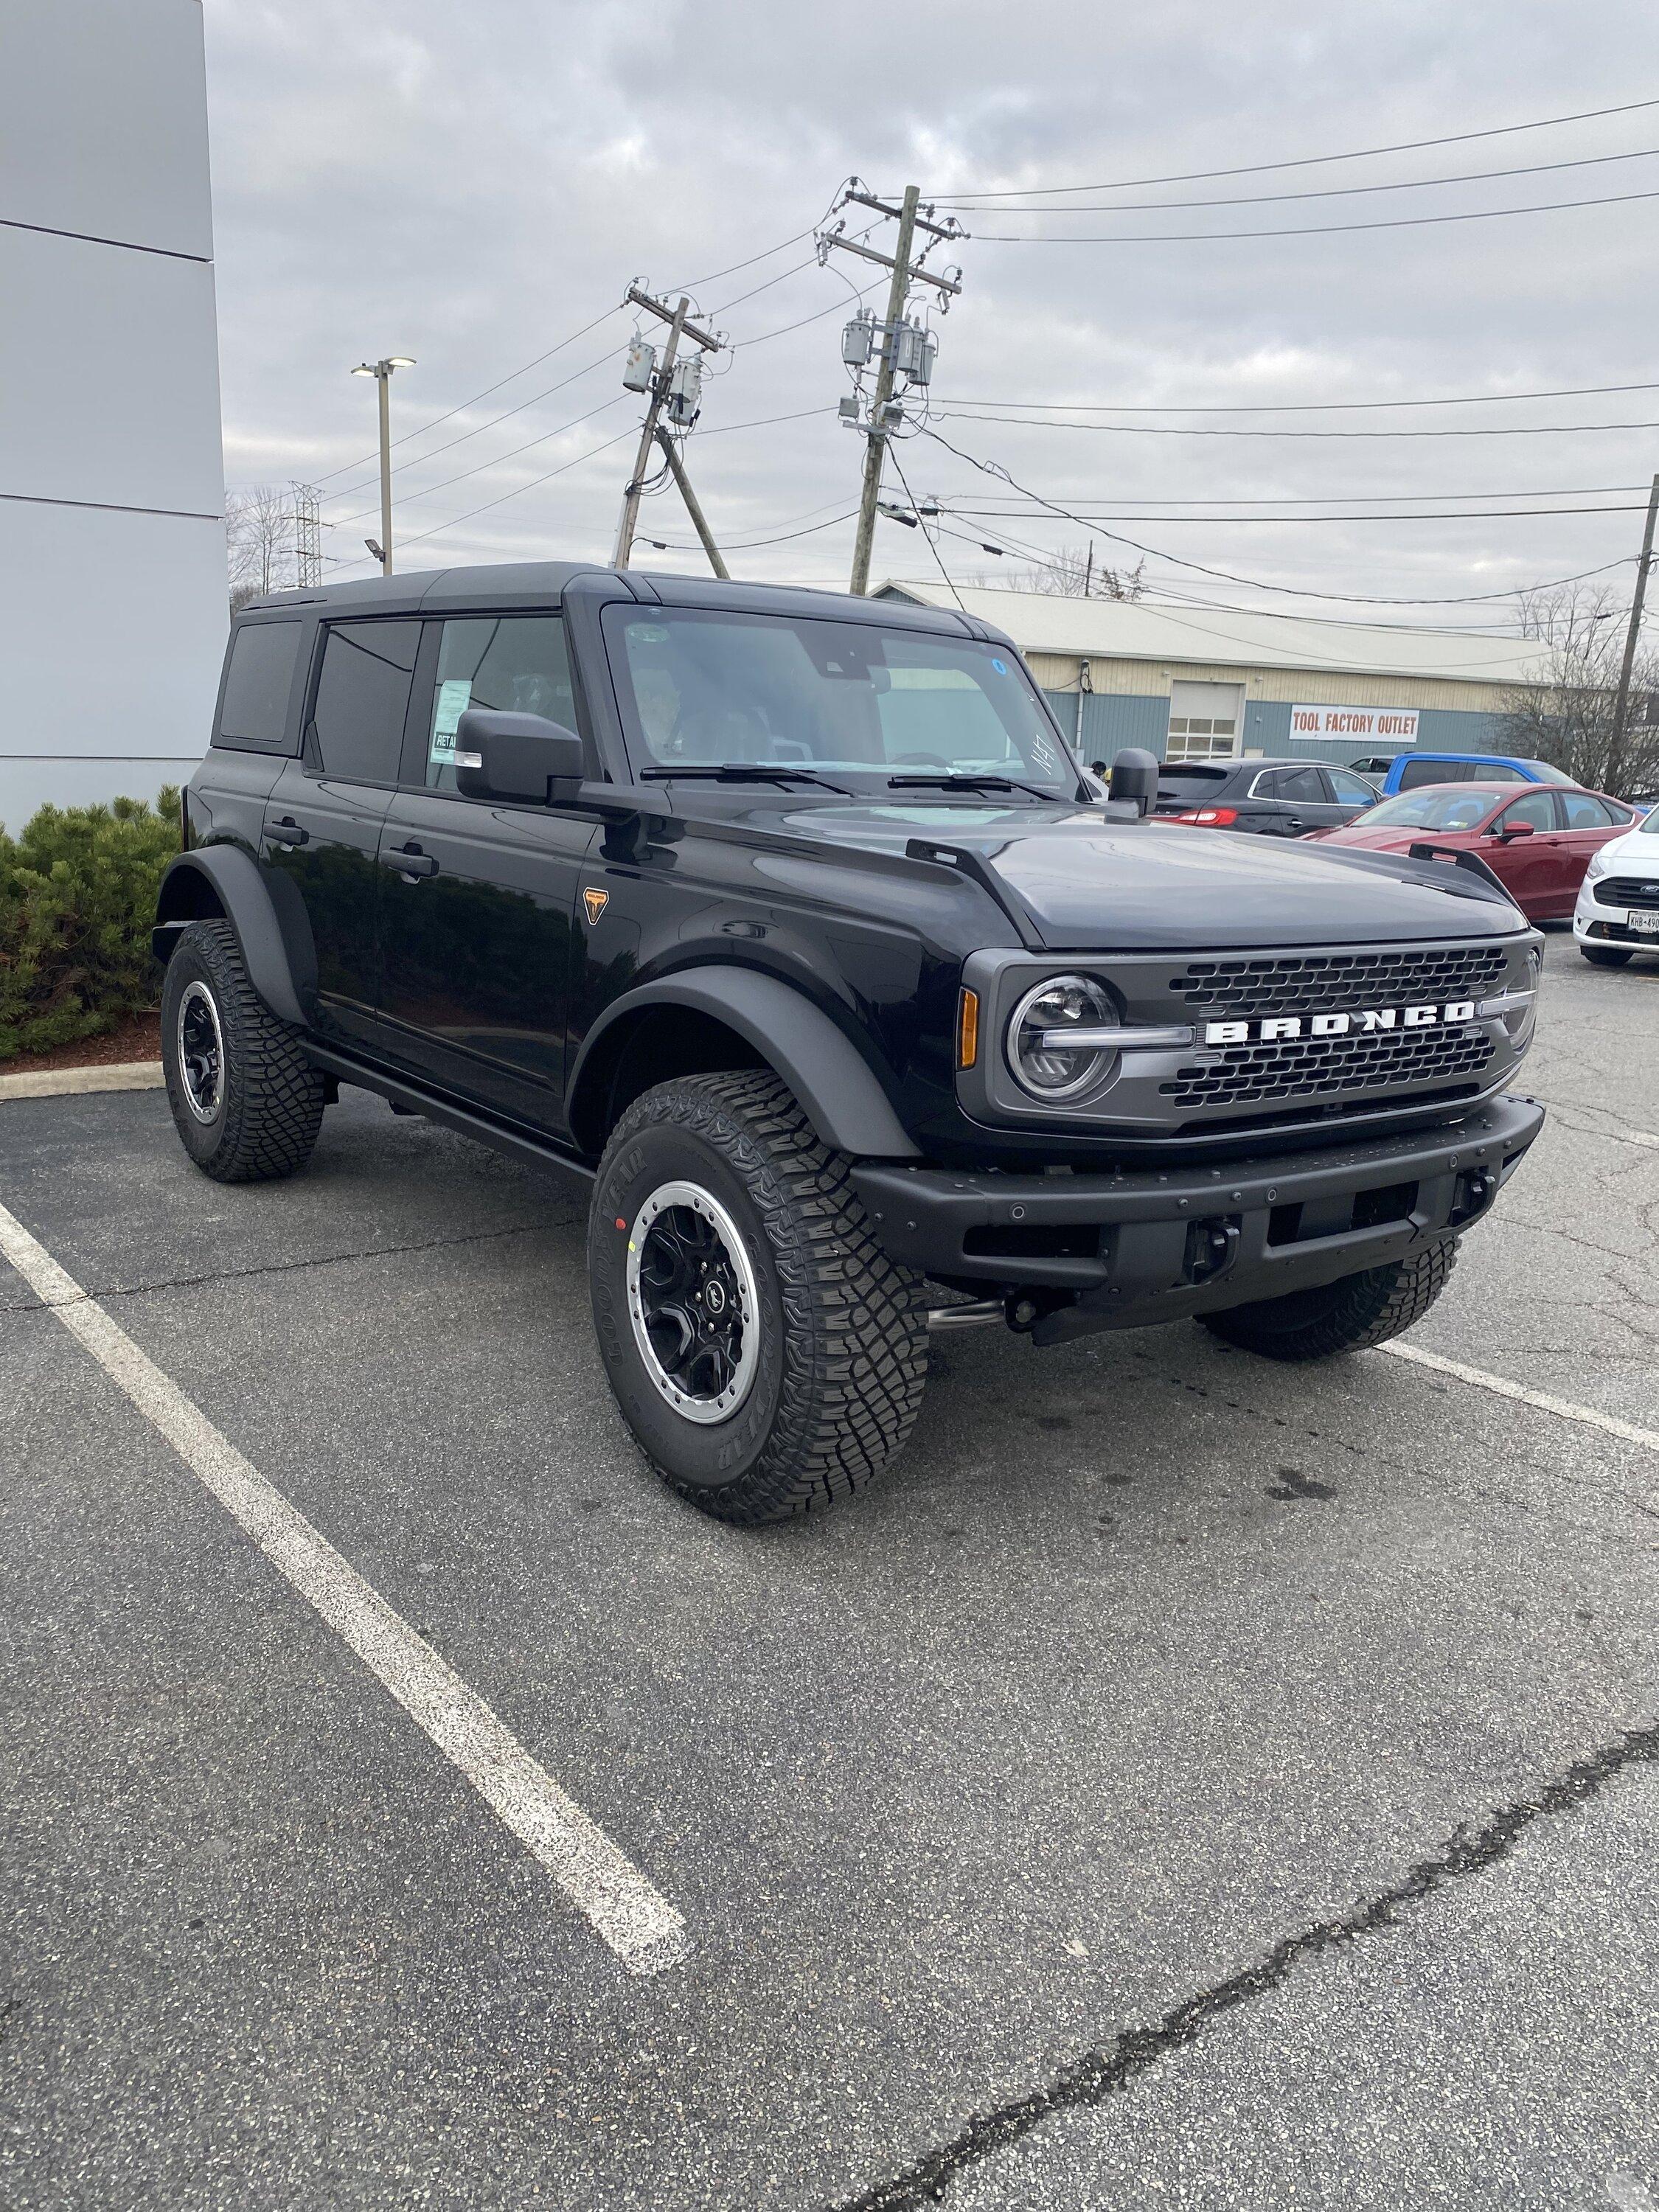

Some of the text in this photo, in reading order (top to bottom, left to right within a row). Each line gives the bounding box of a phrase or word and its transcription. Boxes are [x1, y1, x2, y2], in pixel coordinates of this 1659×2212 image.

[1294, 712, 1416, 734] TOOL FACTORY OUTLET
[1206, 1001, 1475, 1044] BRONCO
